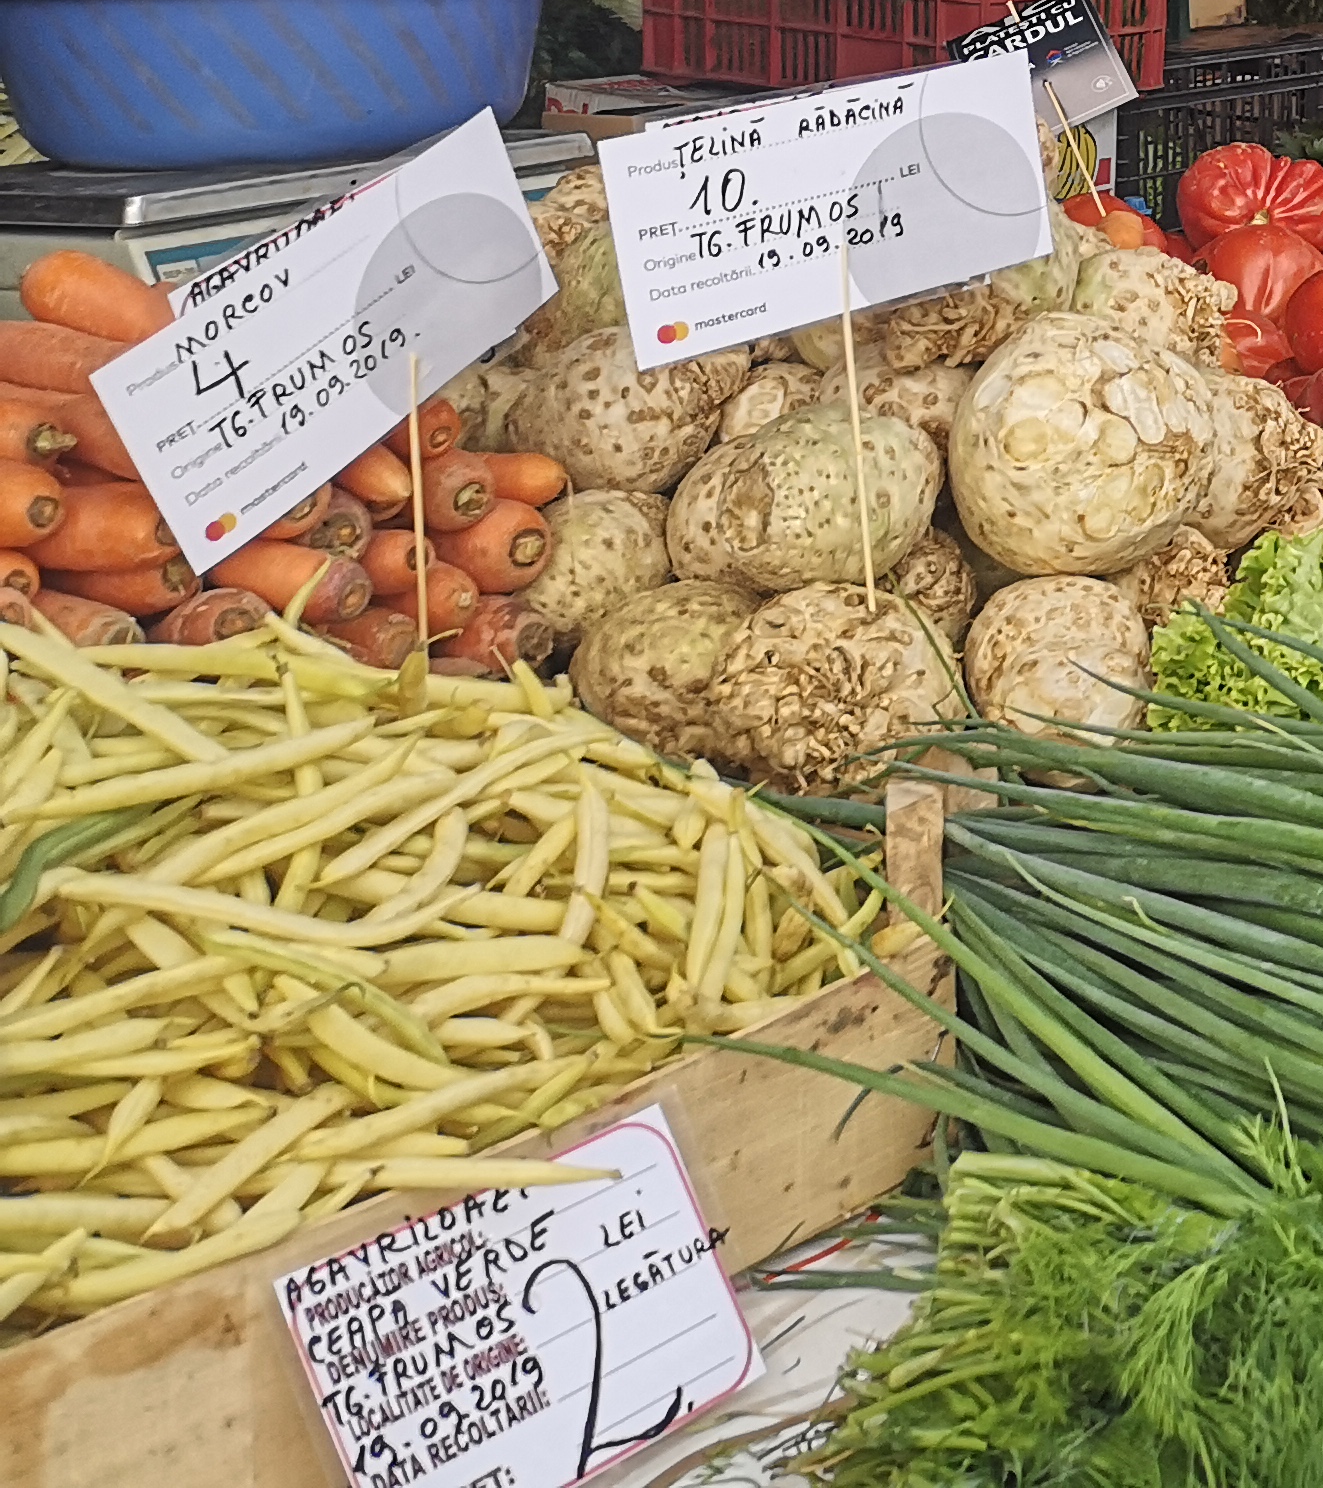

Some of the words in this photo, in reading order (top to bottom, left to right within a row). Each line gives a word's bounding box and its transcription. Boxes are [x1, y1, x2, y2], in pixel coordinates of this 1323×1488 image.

[967, 10, 1084, 62] CARDUL
[627, 157, 679, 178] Produs
[899, 164, 921, 178] LEI
[643, 252, 697, 272] Origine
[649, 285, 687, 302] Data
[690, 265, 753, 291] recoltării
[175, 268, 289, 364] MORCOV
[190, 349, 251, 400] 4
[396, 264, 416, 285] LEI
[694, 302, 768, 332] mastercard
[170, 442, 224, 480] Origine
[185, 477, 223, 507] Data
[240, 461, 308, 516] mastercard
[430, 1208, 555, 1299] VERDE
[326, 1319, 427, 1386] DENUMIRE
[347, 1376, 441, 1443] LOCALITATE
[371, 1452, 427, 1488] DATA
